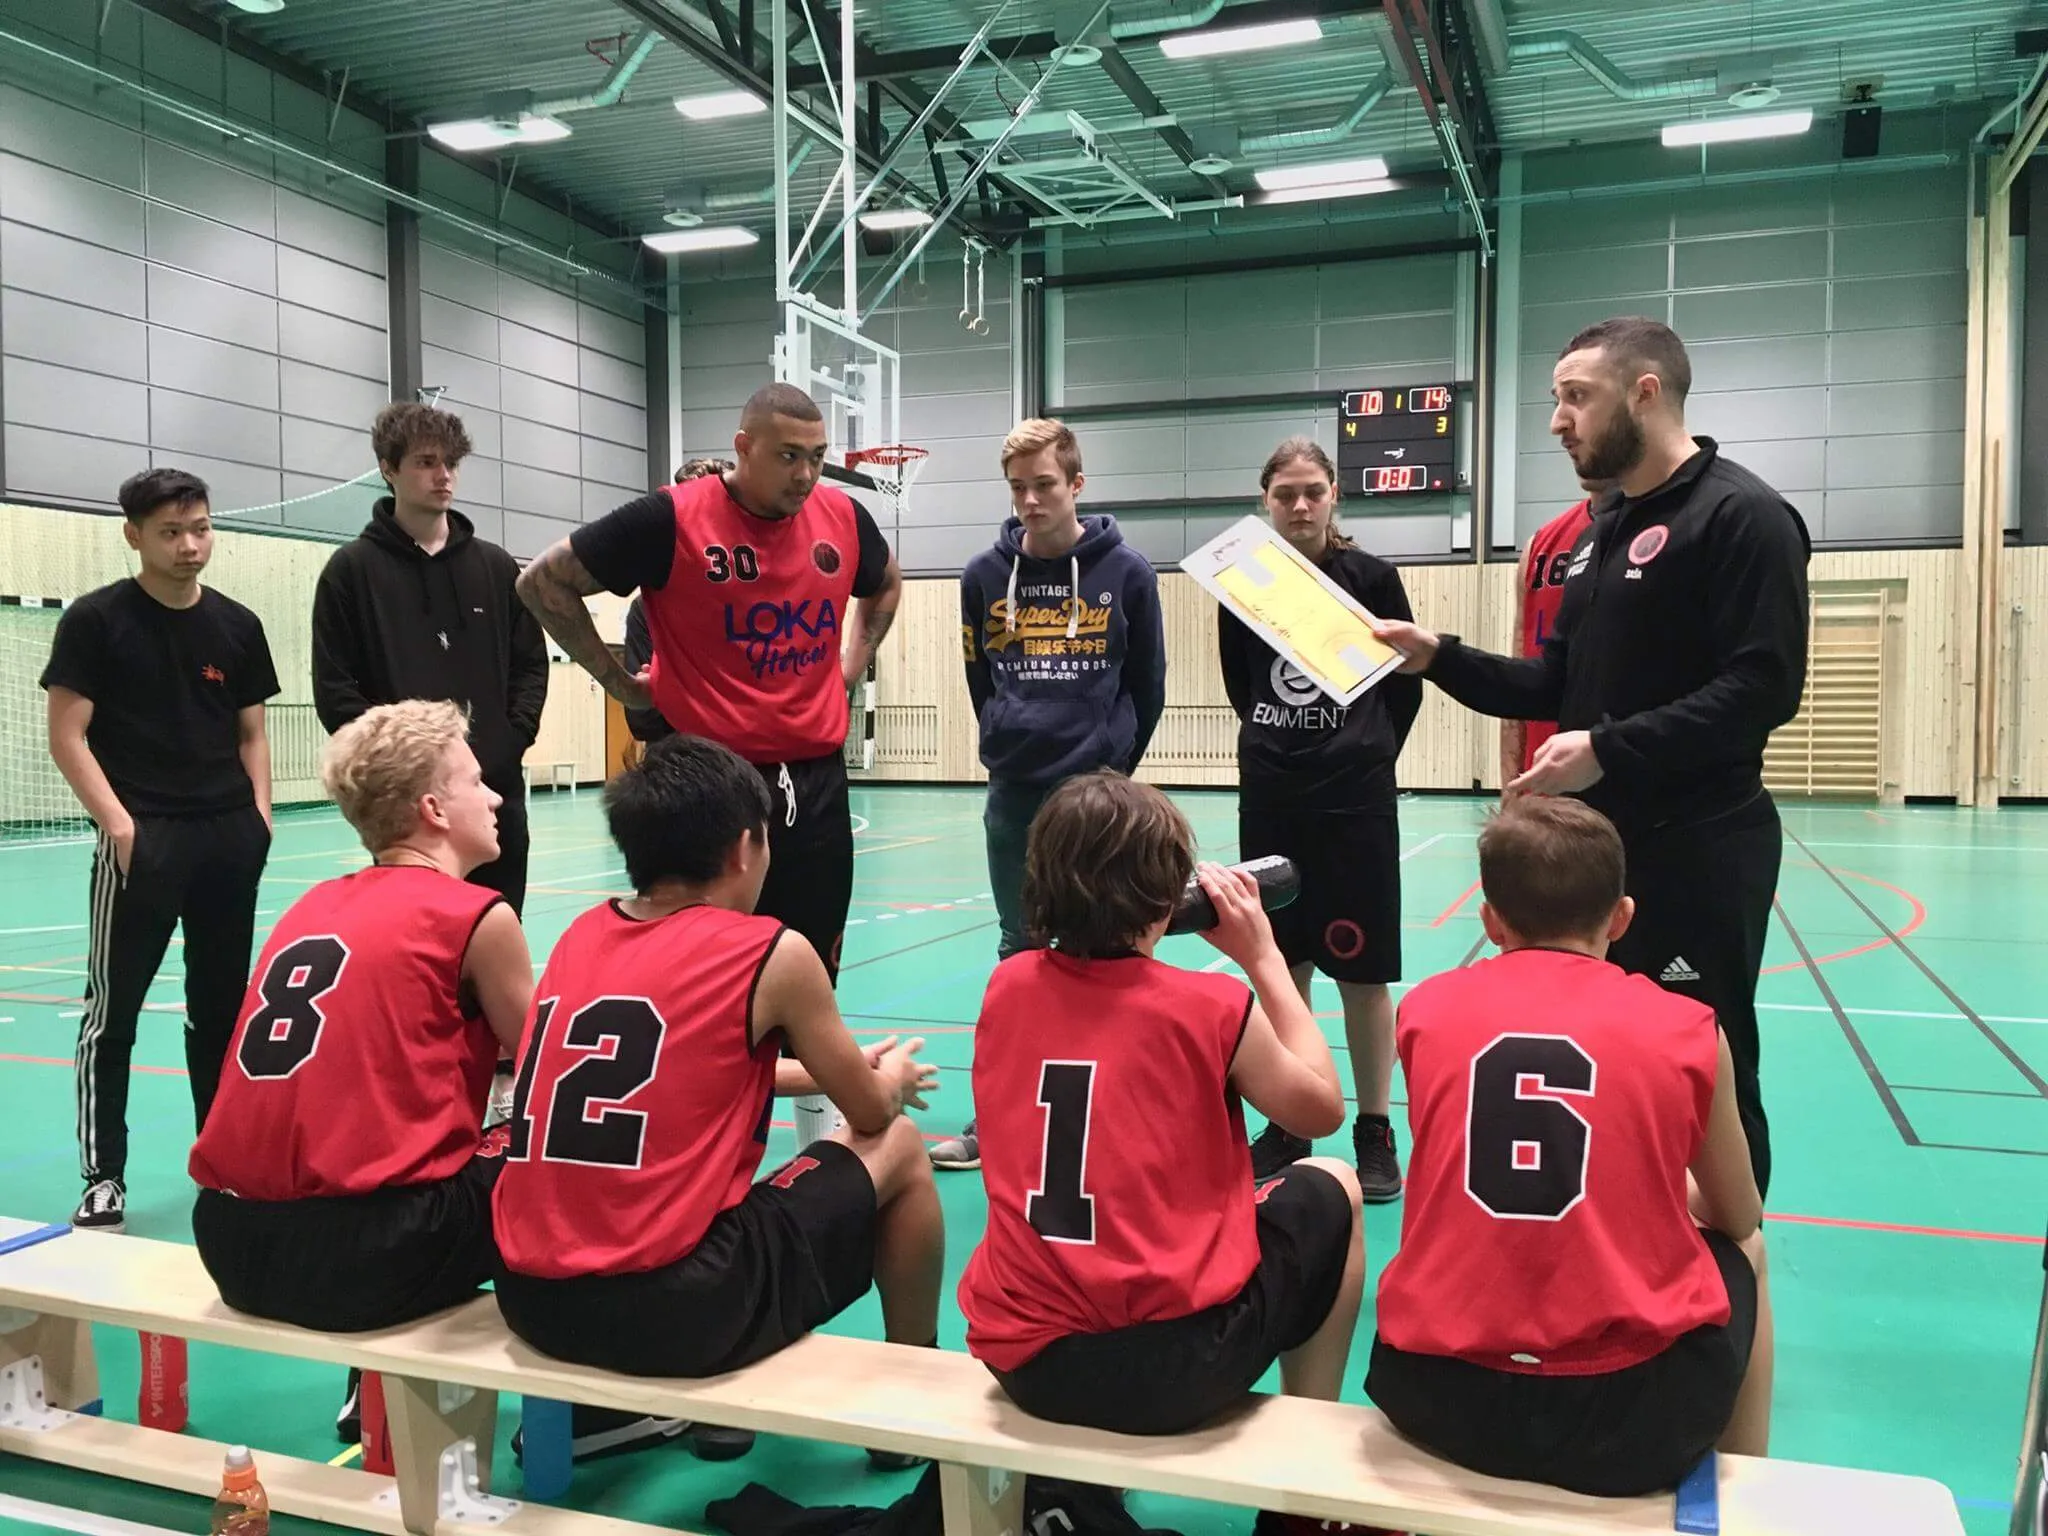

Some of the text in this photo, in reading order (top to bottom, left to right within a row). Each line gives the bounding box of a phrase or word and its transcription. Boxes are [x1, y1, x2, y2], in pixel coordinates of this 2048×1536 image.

[1360, 391, 1380, 413] 10
[1395, 393, 1402, 409] 1
[1424, 389, 1444, 409] 14
[1345, 416, 1448, 437] 4 3
[704, 544, 760, 584] 30
[1532, 551, 1571, 590] 16
[1020, 584, 1071, 598] VINTAGE
[724, 599, 837, 643] LOKA
[1252, 703, 1352, 730] EDUMENT
[237, 933, 352, 1081] 8
[507, 995, 668, 1171] 12
[1464, 1031, 1598, 1222] 6
[1025, 1059, 1098, 1246] 1
